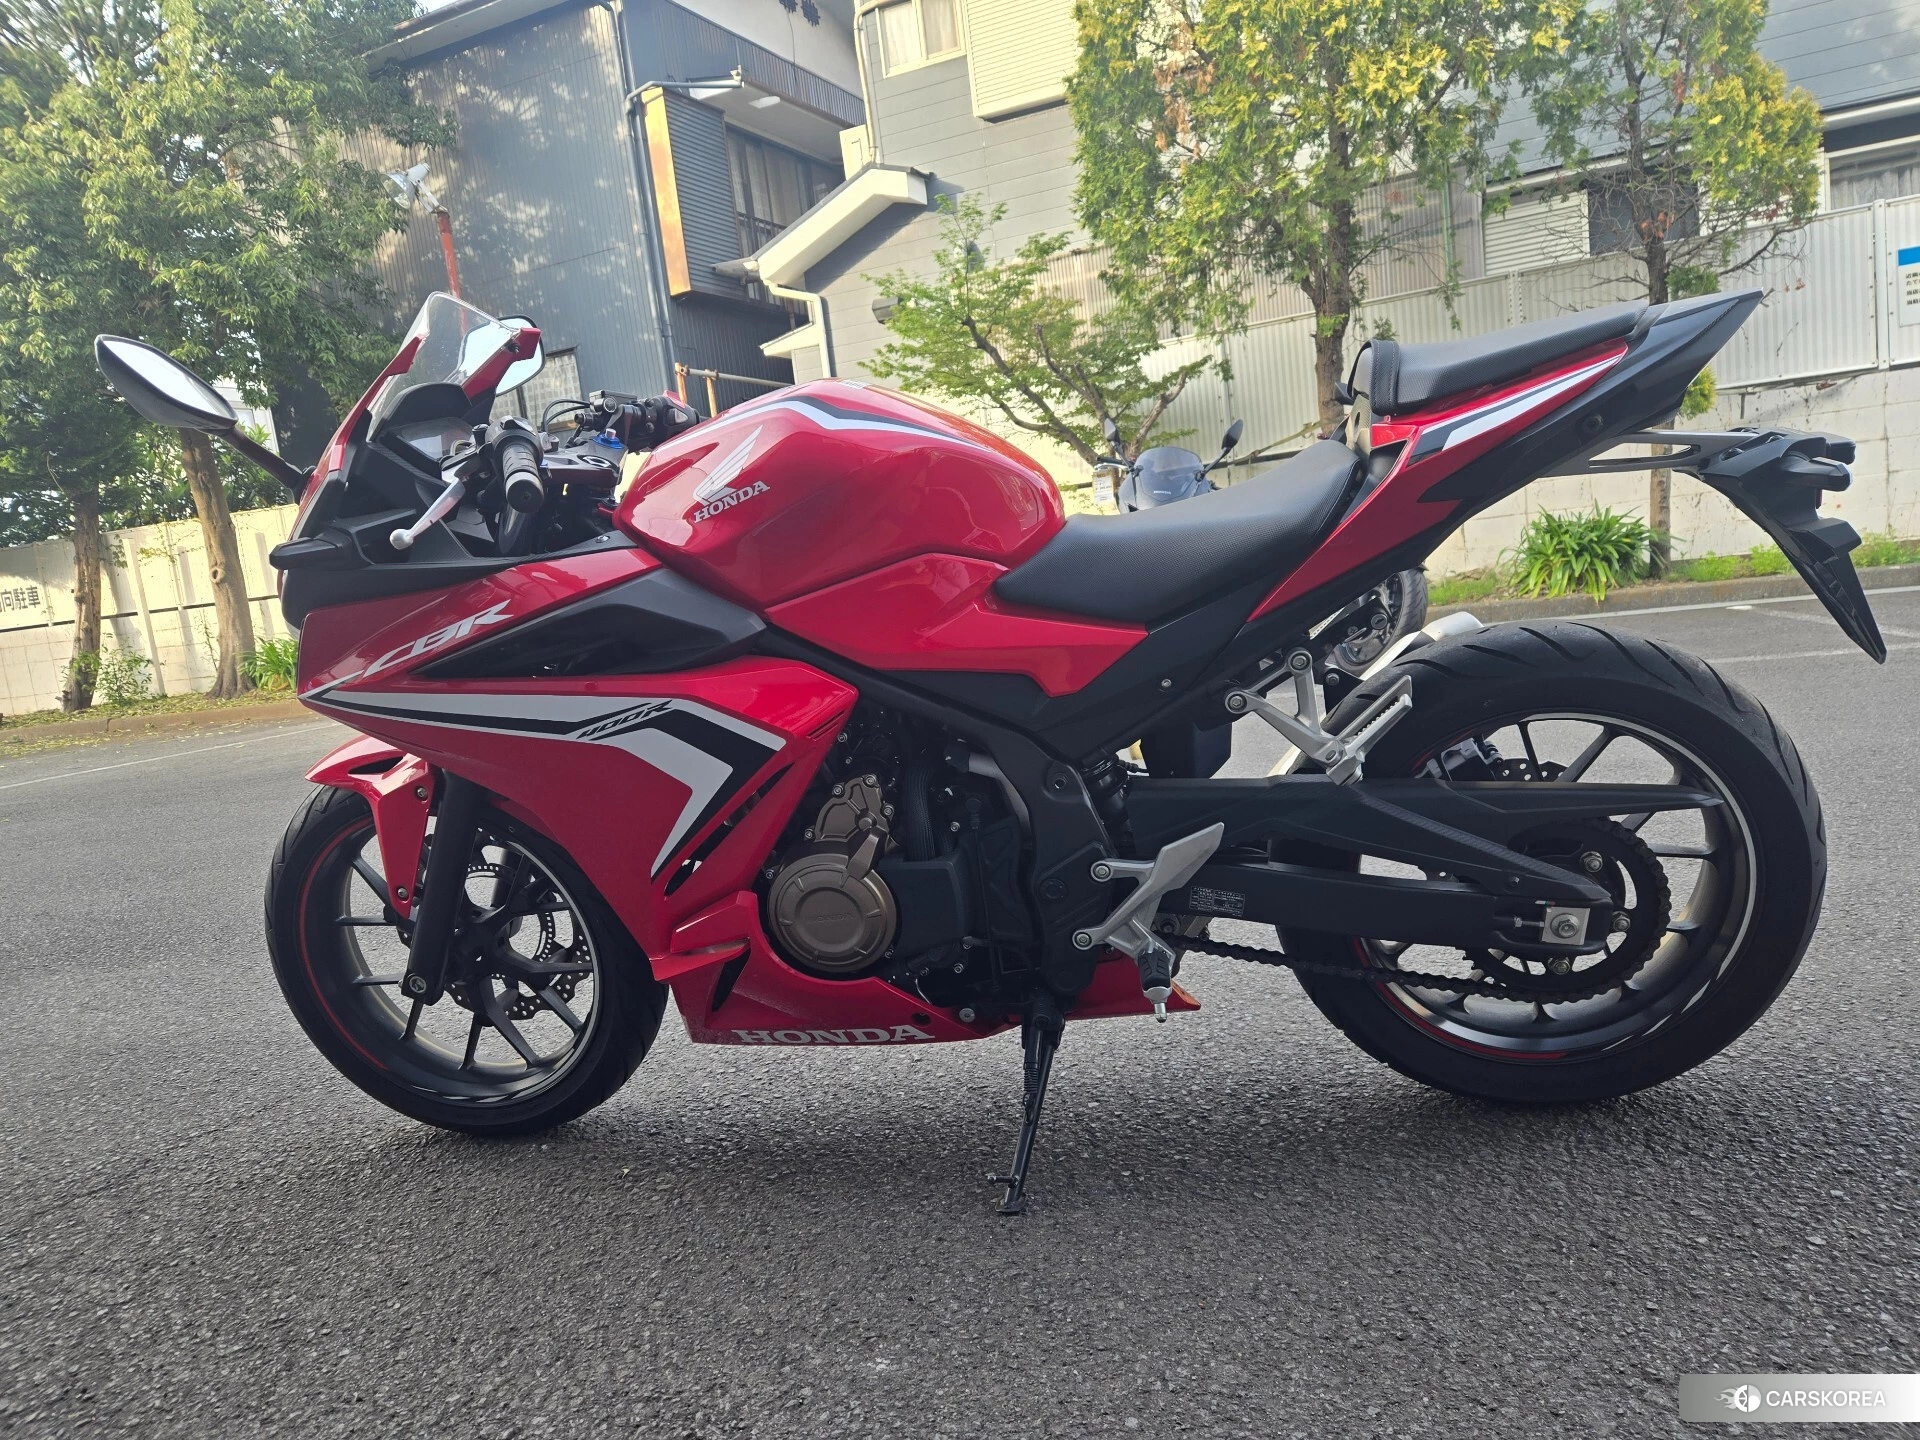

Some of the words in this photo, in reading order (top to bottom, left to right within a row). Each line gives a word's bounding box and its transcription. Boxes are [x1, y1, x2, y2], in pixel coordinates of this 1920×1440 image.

[694, 480, 770, 523] HONDA
[0, 585, 41, 612] 向駐車
[362, 599, 514, 678] CBR
[576, 699, 673, 739] 400R
[731, 1024, 936, 1043] HONDA
